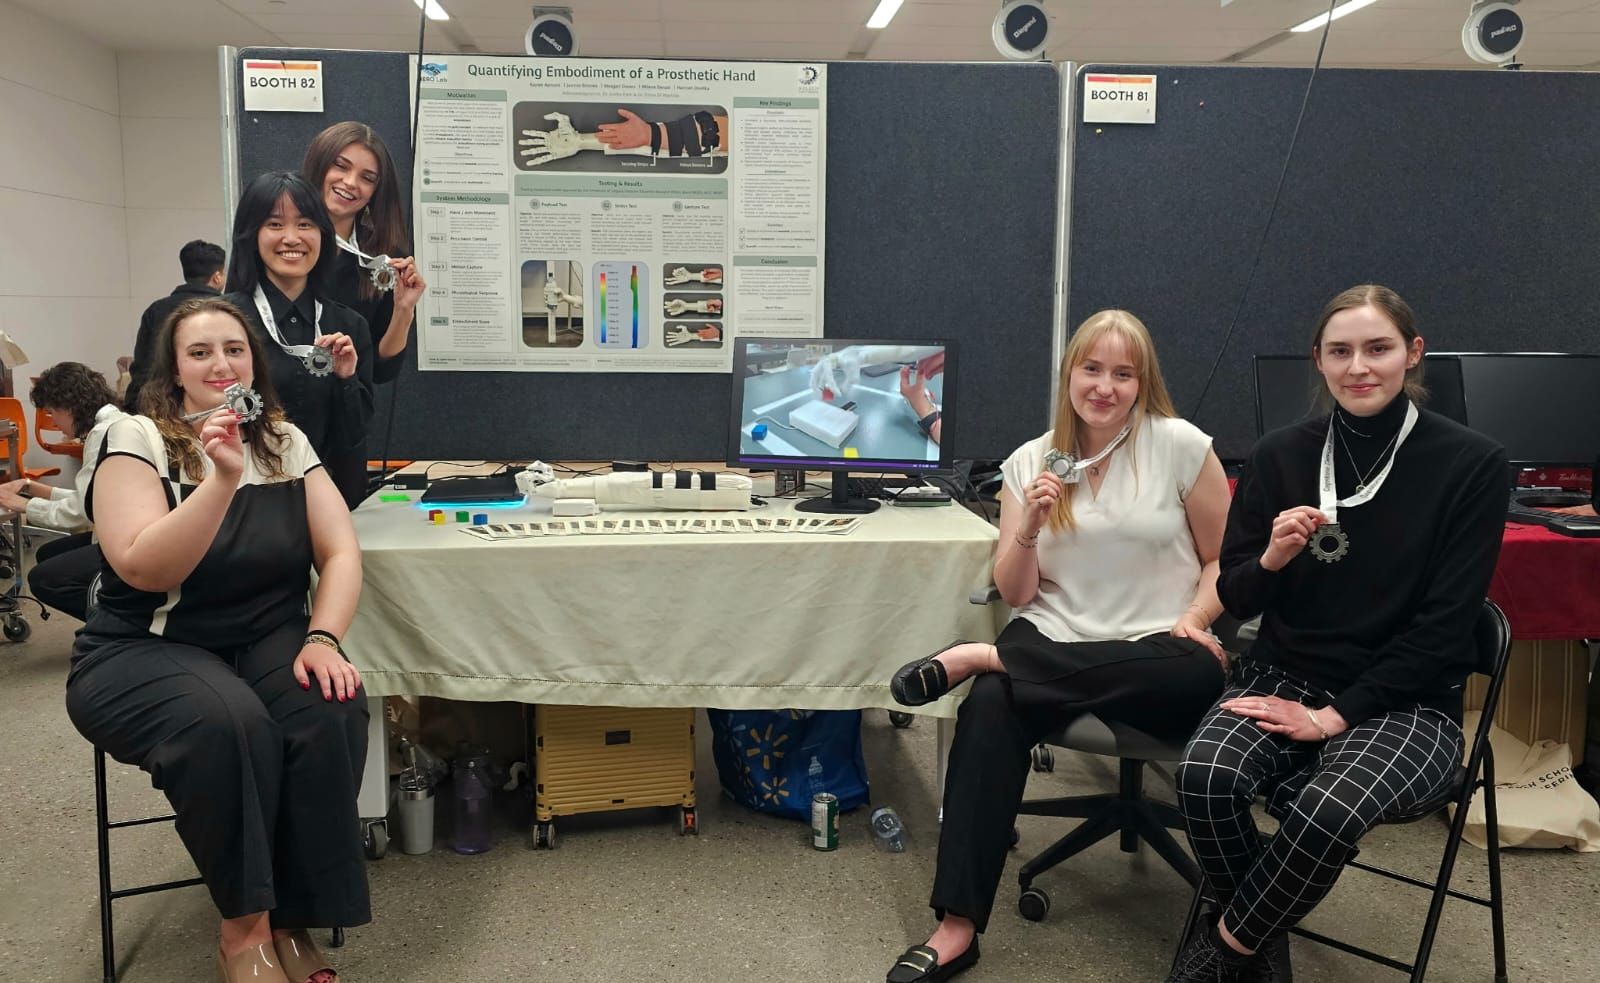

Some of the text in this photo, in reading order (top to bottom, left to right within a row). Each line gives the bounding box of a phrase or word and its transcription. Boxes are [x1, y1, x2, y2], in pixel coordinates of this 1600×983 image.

[467, 64, 756, 81] Quantifying Embodiment of a Prosthetic Hand
[250, 77, 315, 89] BOOTH 82
[1091, 90, 1148, 101] BOOTH 81
